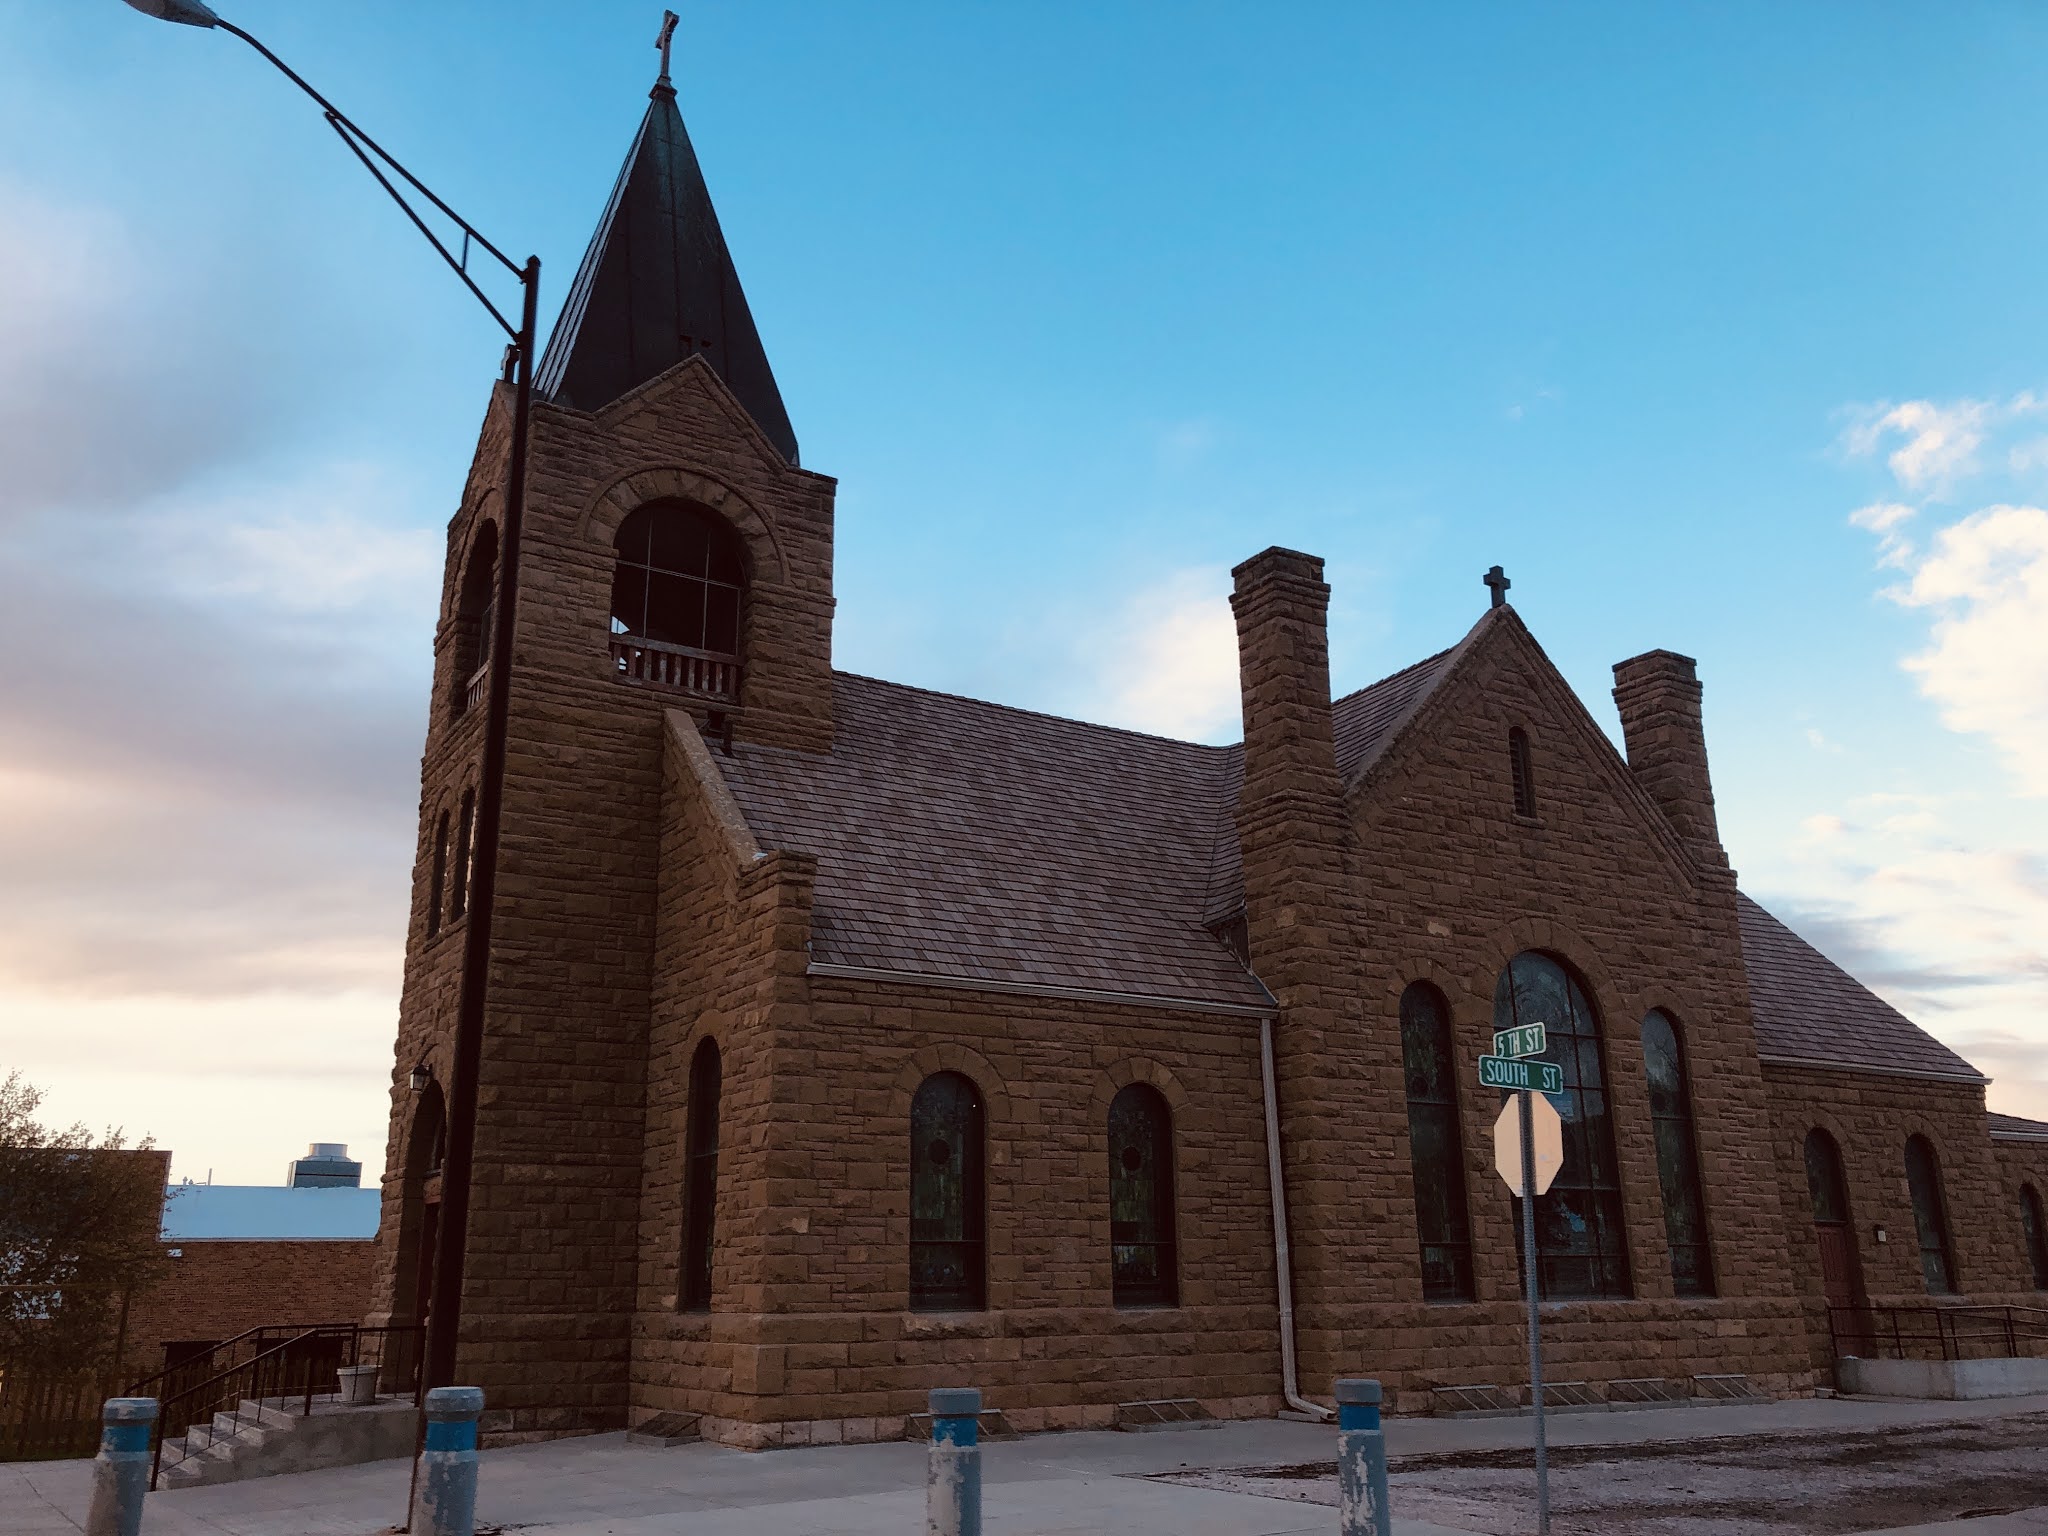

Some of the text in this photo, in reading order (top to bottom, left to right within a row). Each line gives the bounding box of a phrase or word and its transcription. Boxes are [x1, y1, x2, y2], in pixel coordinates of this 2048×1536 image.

[1525, 1027, 1540, 1052] ST
[1486, 1060, 1556, 1090] SOUTH ST
